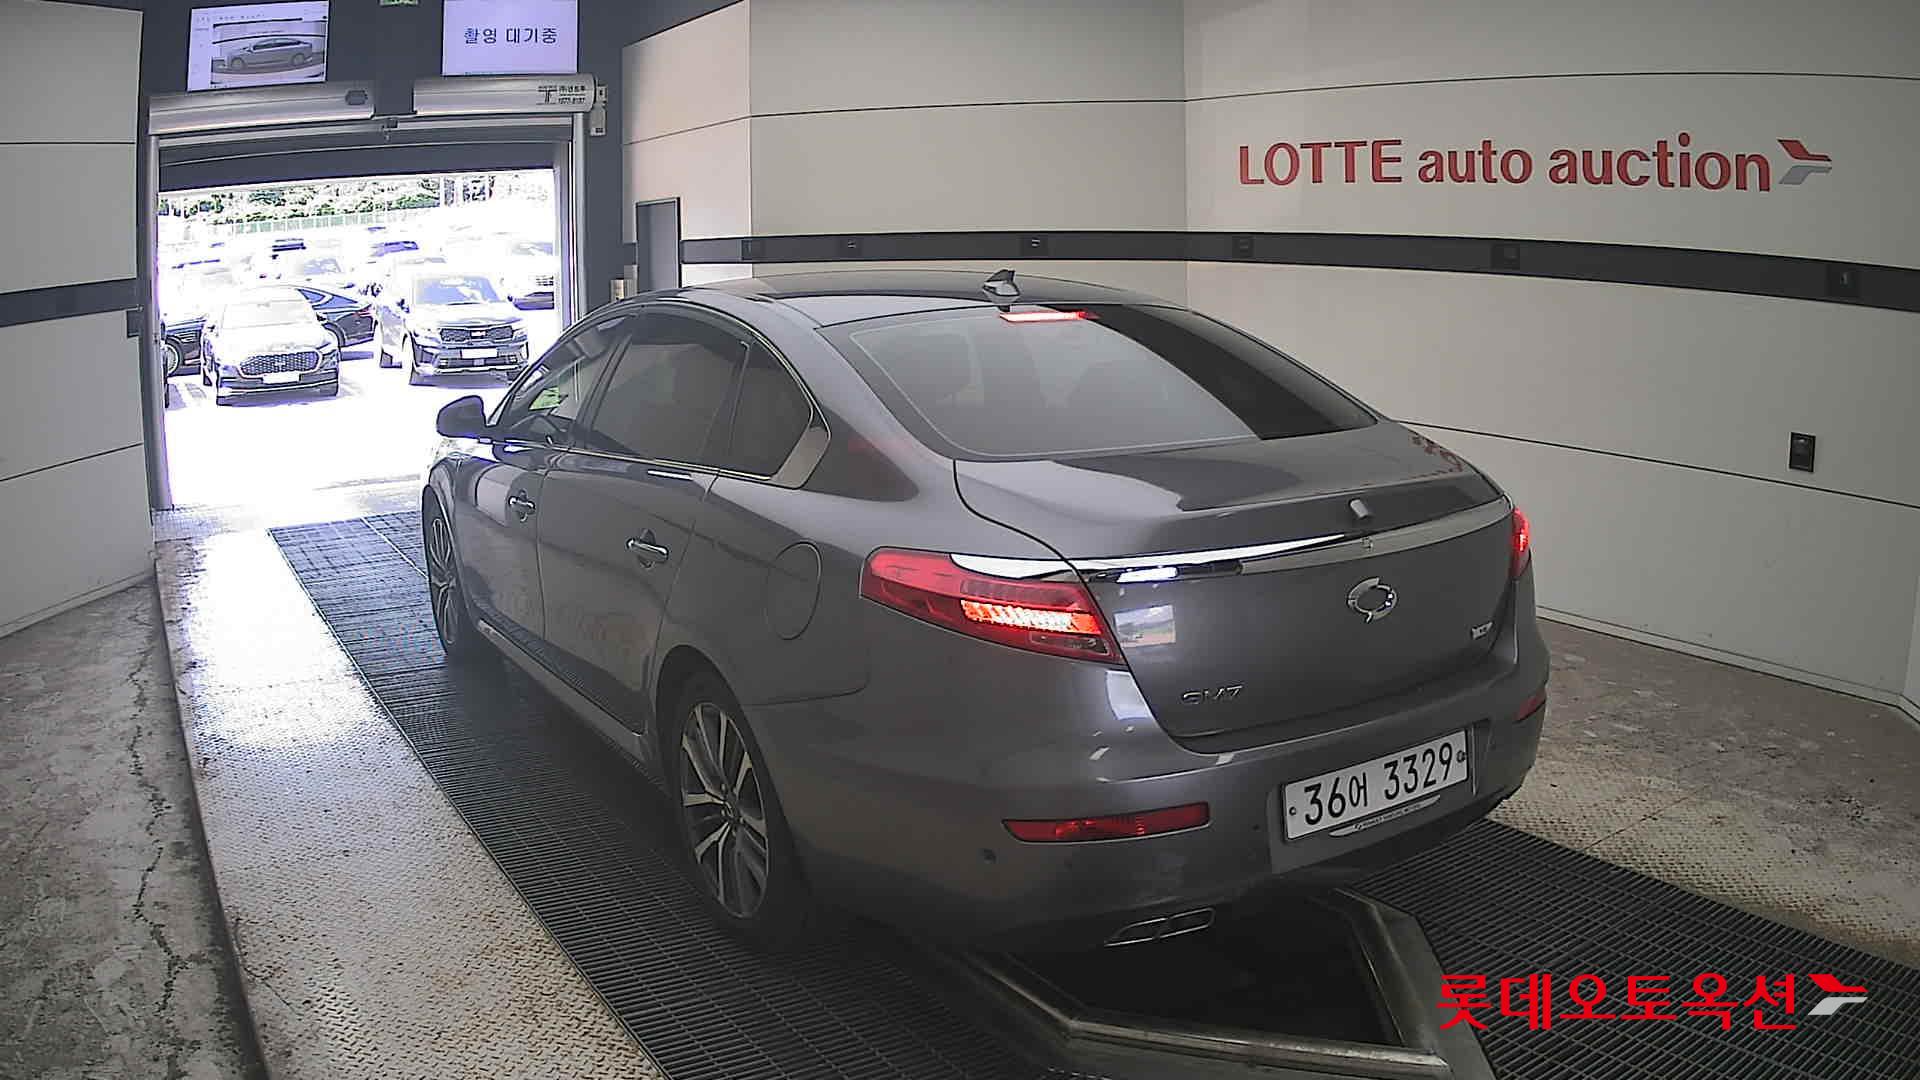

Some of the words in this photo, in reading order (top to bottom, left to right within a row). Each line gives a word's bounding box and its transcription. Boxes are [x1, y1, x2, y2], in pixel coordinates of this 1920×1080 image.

[464, 27, 497, 44] 촬영
[506, 26, 558, 44] 대기중
[1239, 139, 1402, 186] LOTTE
[1417, 140, 1533, 185] auto
[1548, 132, 1771, 192] auction
[1303, 771, 1369, 826] 36어
[1383, 742, 1454, 801] 3329
